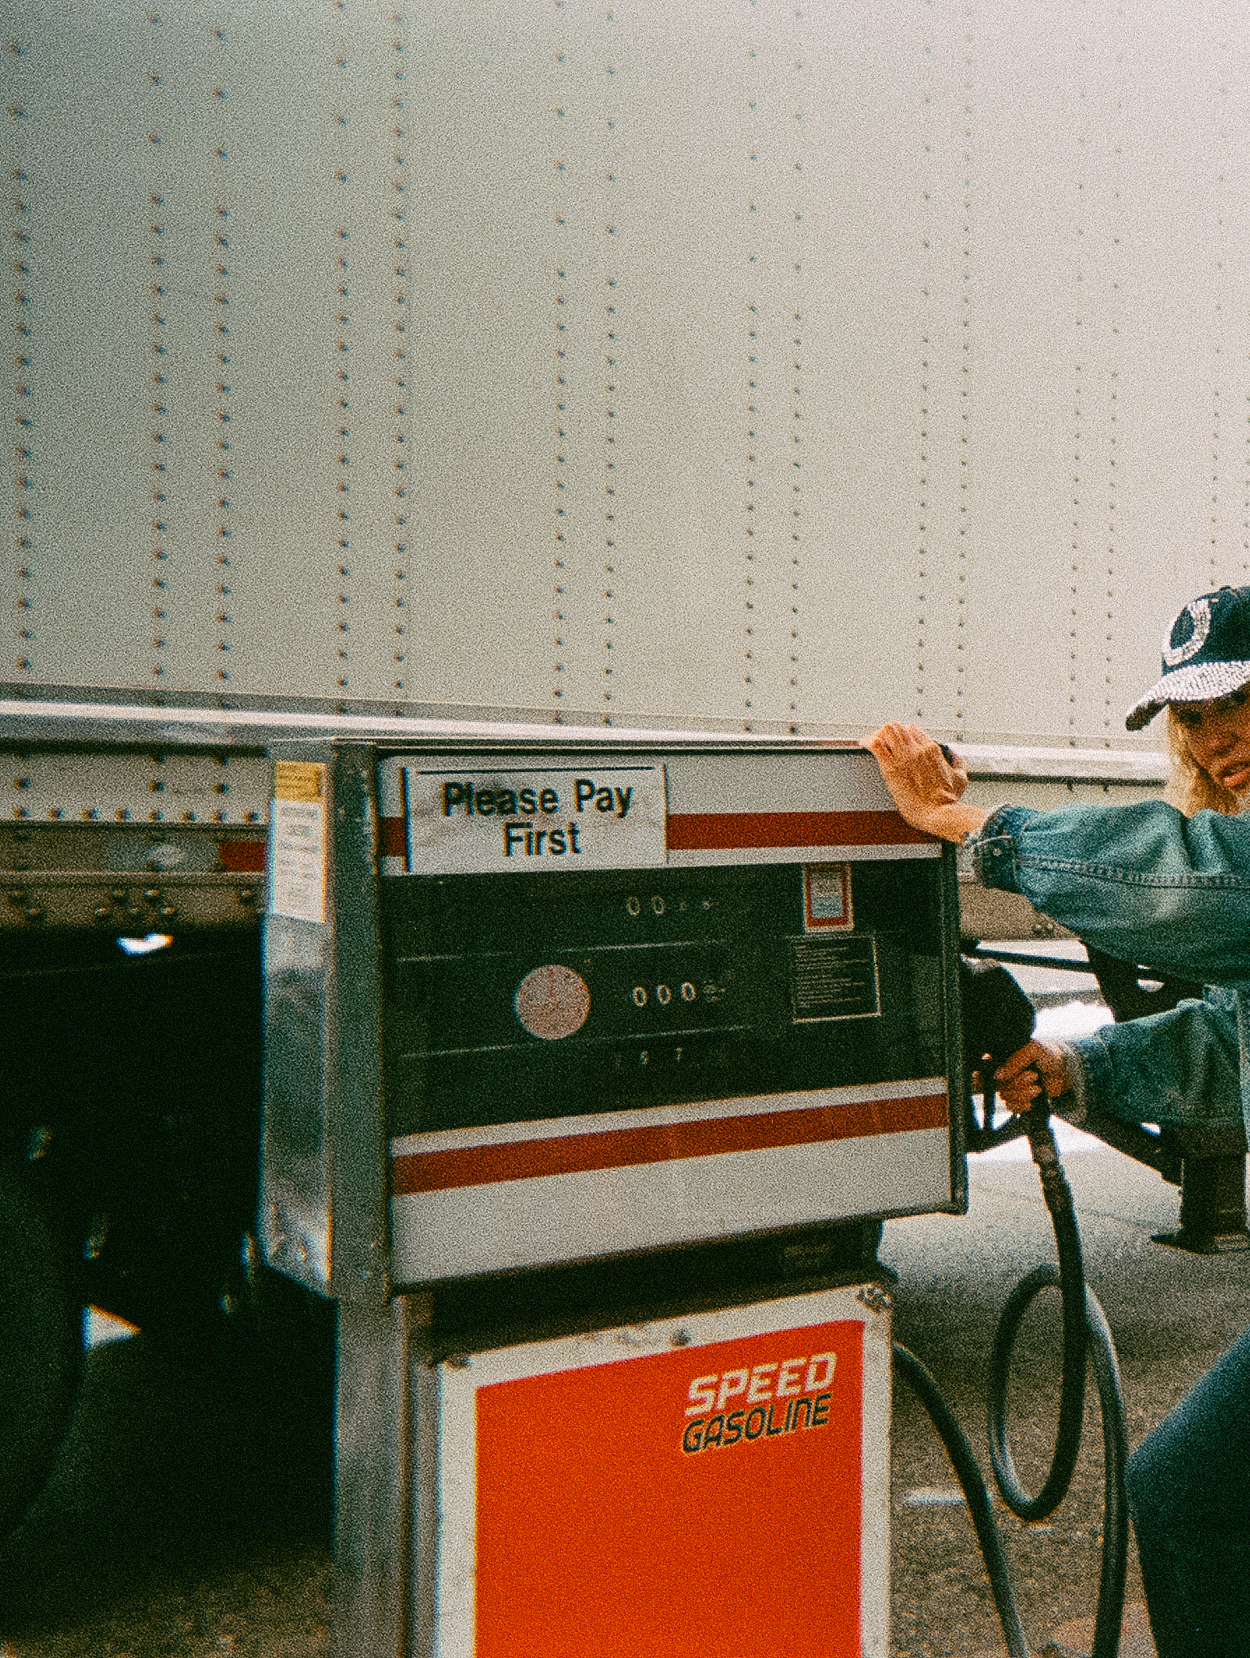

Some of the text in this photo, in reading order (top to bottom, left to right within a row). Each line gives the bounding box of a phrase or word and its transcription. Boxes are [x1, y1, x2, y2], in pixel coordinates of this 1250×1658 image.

[442, 778, 635, 819] Please Pay
[503, 821, 583, 857] First
[684, 1352, 837, 1416] SPEED
[681, 1392, 833, 1455] GASOLINE
